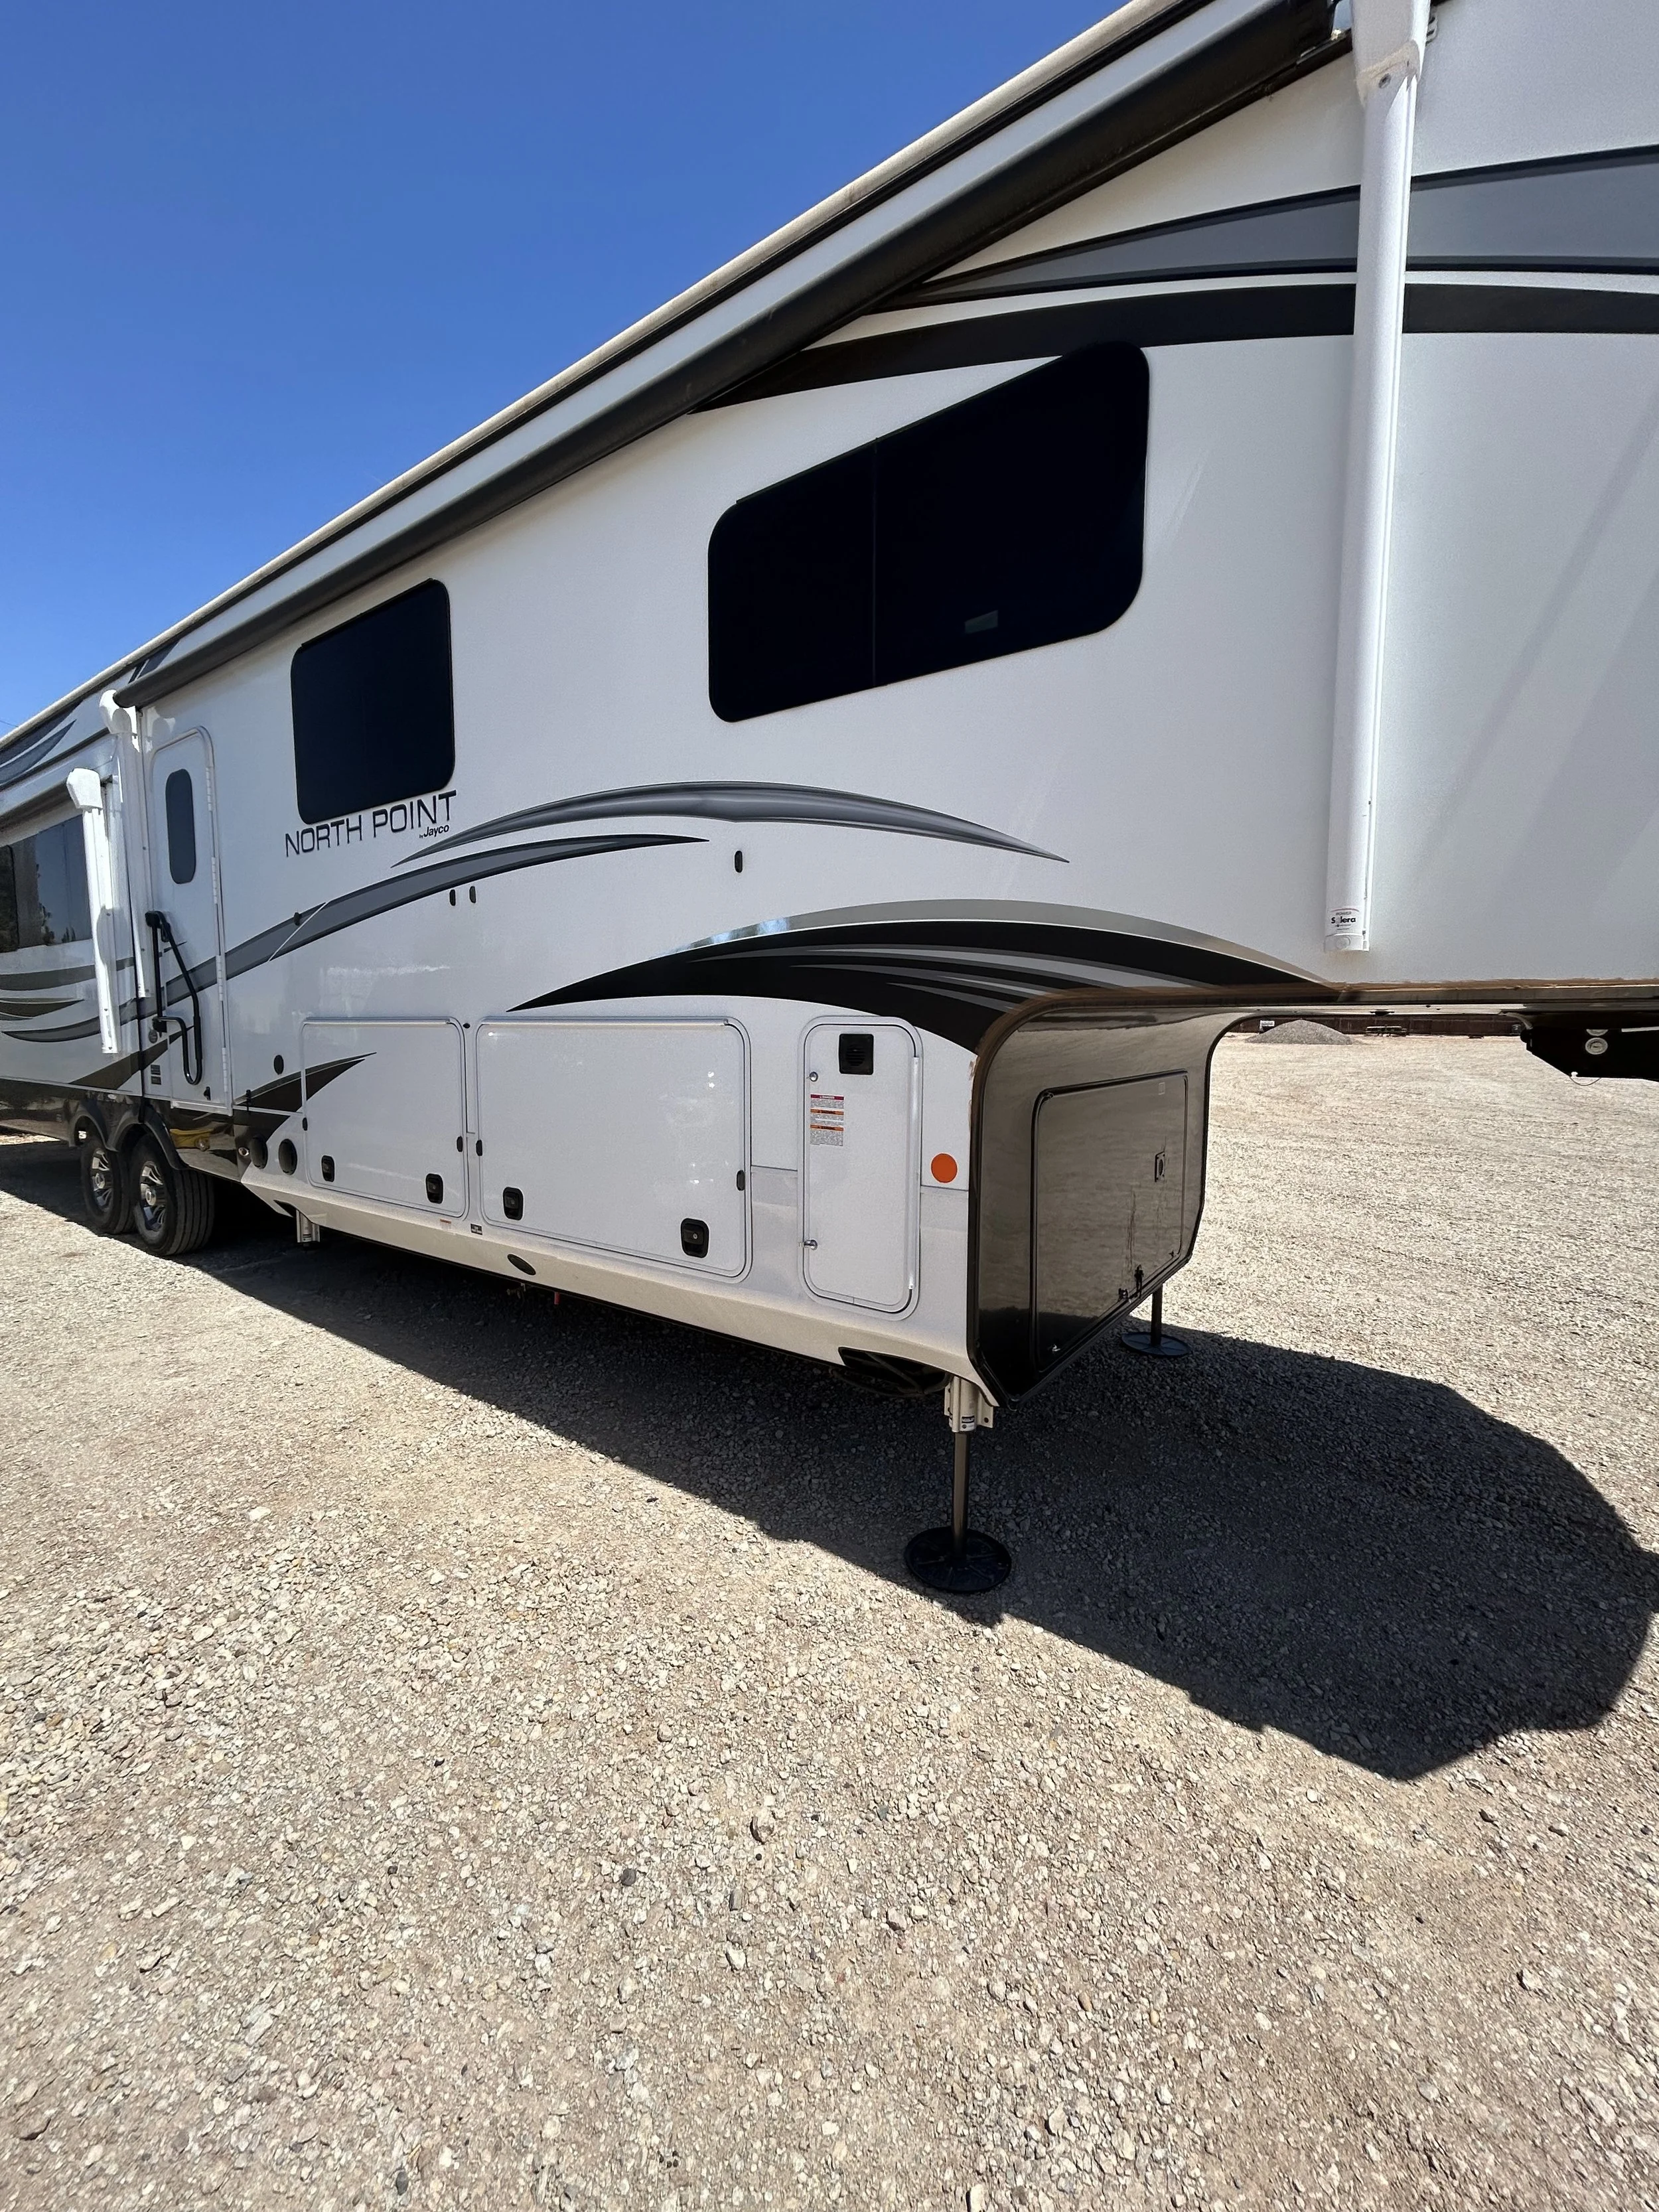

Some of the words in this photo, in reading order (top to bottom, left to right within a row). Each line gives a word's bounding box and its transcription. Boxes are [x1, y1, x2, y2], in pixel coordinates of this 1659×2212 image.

[285, 814, 362, 857] NORTH
[372, 790, 457, 838] POINT
[423, 824, 449, 837] Jayco
